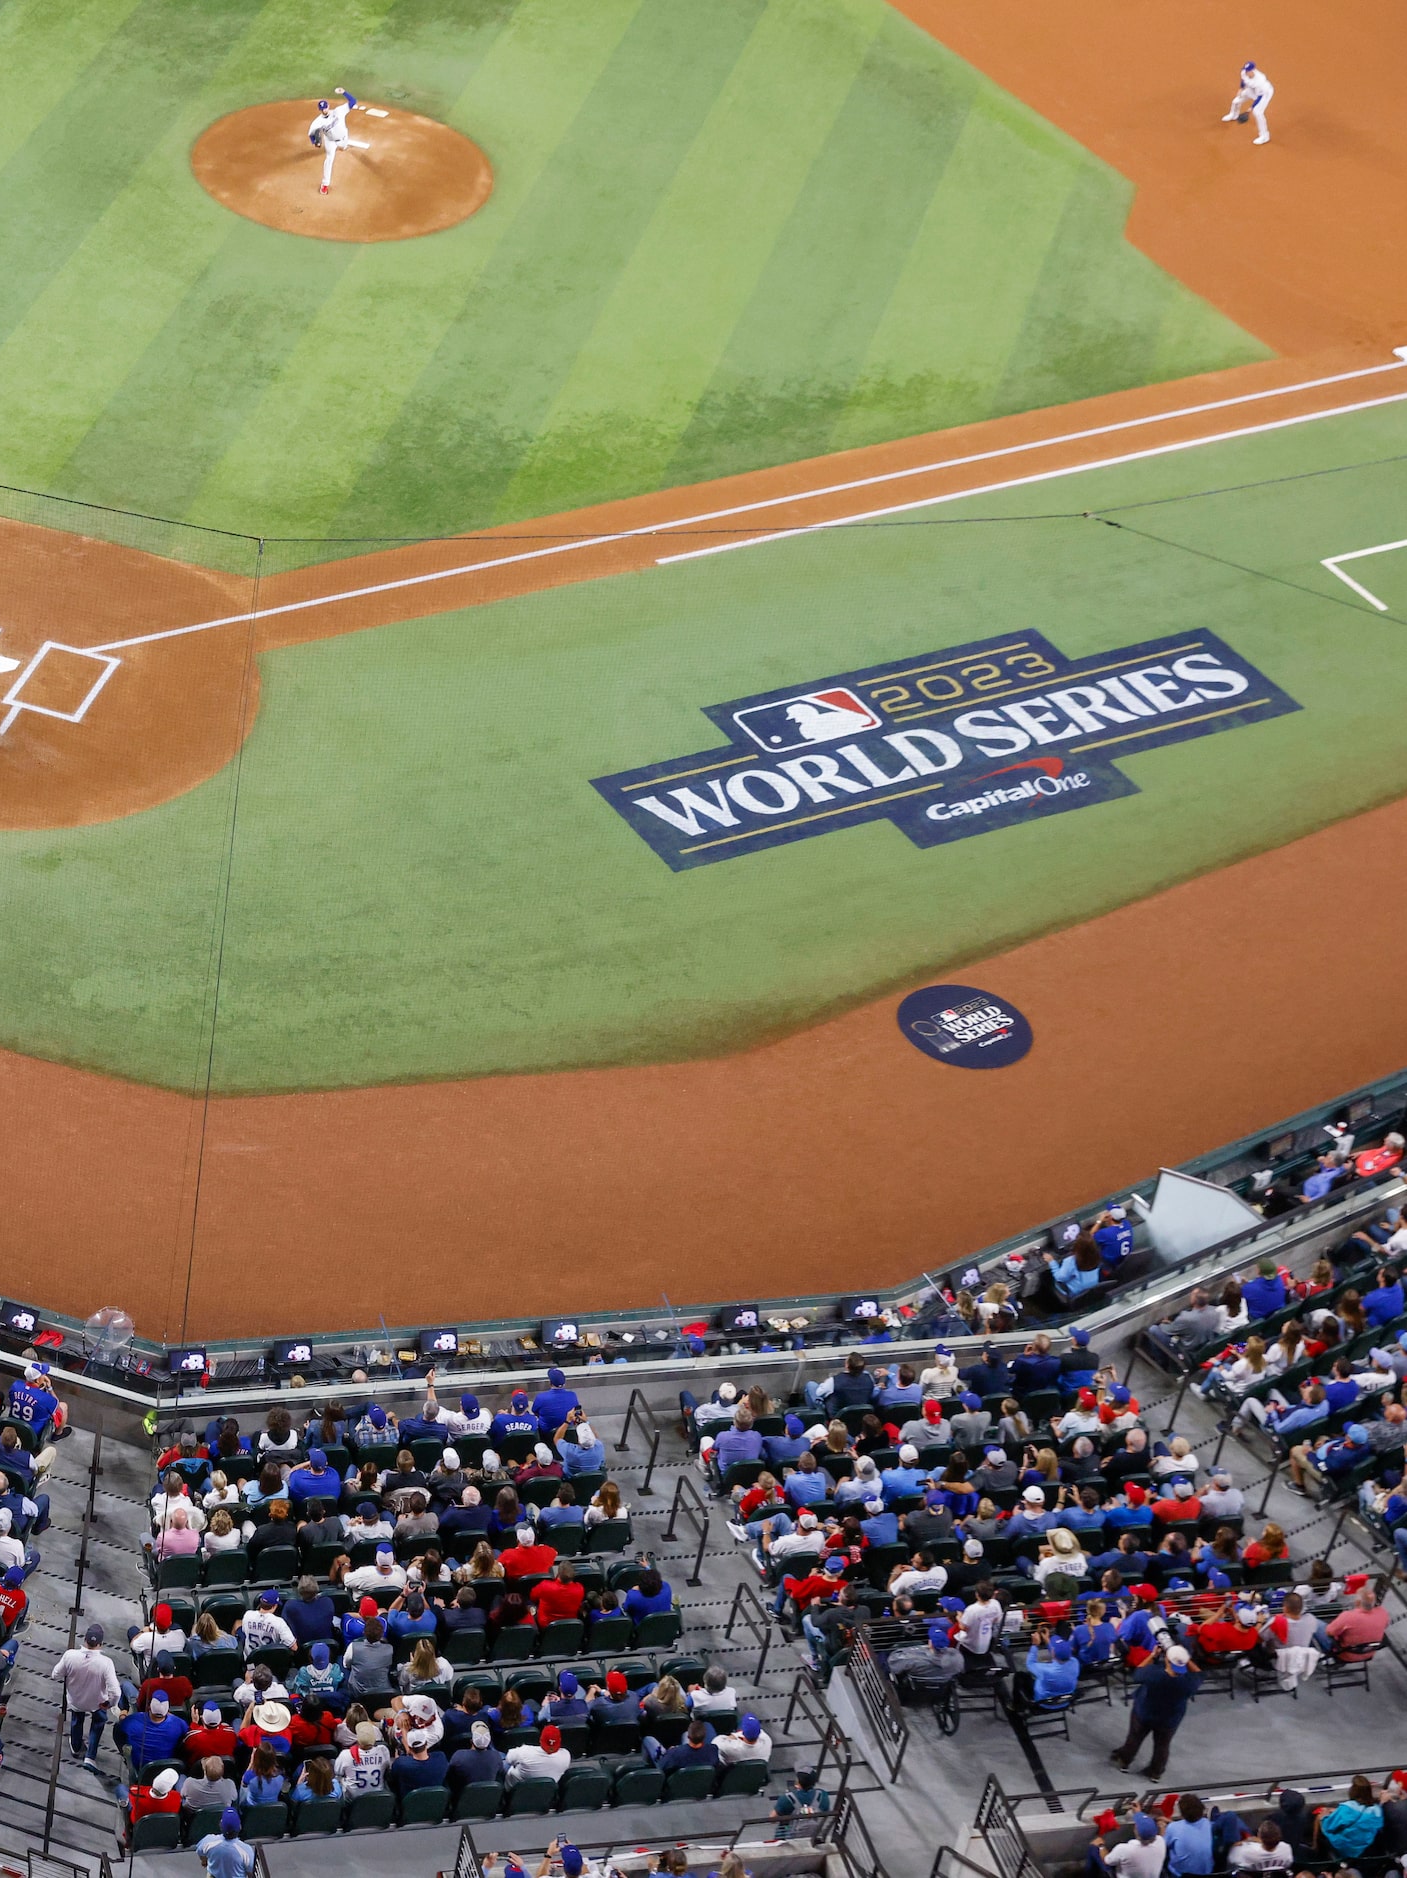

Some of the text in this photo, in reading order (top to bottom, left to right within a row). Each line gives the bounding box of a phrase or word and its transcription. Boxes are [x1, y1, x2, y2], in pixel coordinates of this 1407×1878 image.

[871, 653, 1056, 712] 2023
[632, 653, 1251, 837] WORLD SERIES
[943, 1005, 1002, 1034] WORLD
[953, 1013, 1015, 1044] SERIES
[1120, 1240, 1130, 1256] 6
[14, 1391, 38, 1407] BELTRE
[11, 1400, 34, 1422] 29
[456, 1422, 485, 1432] SEAGER
[505, 1421, 533, 1432] SEAGER
[356, 1769, 381, 1789] 53
